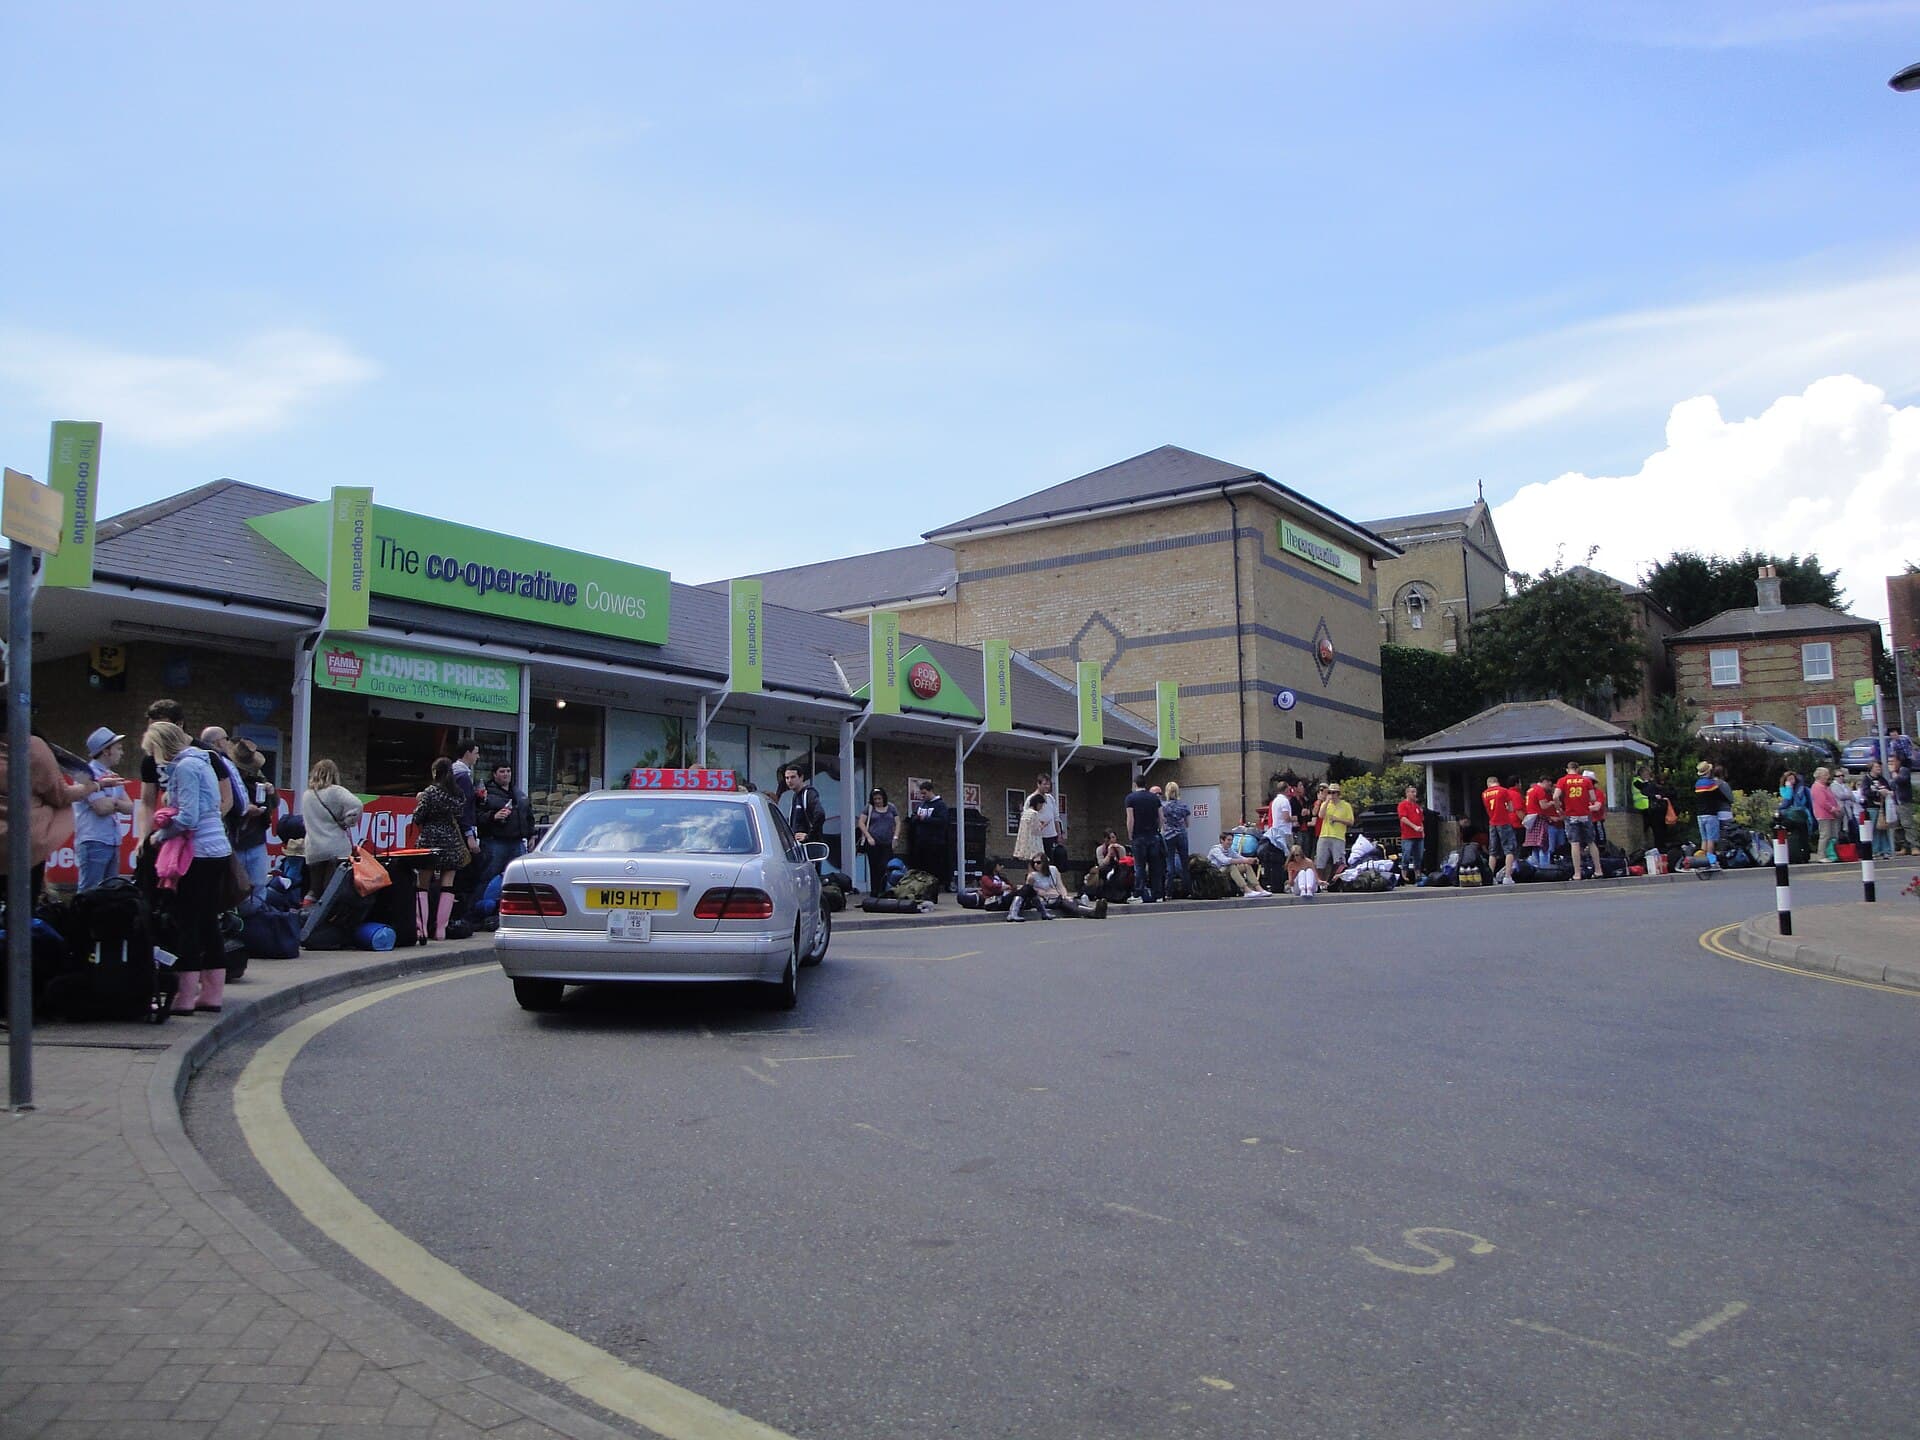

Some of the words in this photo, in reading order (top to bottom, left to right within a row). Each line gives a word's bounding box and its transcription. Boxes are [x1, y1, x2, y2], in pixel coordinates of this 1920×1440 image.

[73, 461, 90, 545] co-operative
[351, 519, 364, 592] co-operative
[375, 535, 419, 575] The
[425, 553, 578, 606] co-operative
[585, 582, 646, 619] Cowes
[747, 609, 759, 666] co-operative
[328, 655, 361, 669] FAMILY
[368, 653, 439, 682] LOWER
[371, 678, 385, 691] On
[388, 682, 407, 694] over
[913, 679, 938, 692] OFFICE
[635, 769, 662, 788] 52
[673, 769, 700, 789] 55
[707, 770, 733, 789] 55
[601, 890, 625, 906] W19
[630, 891, 661, 906] HTT
